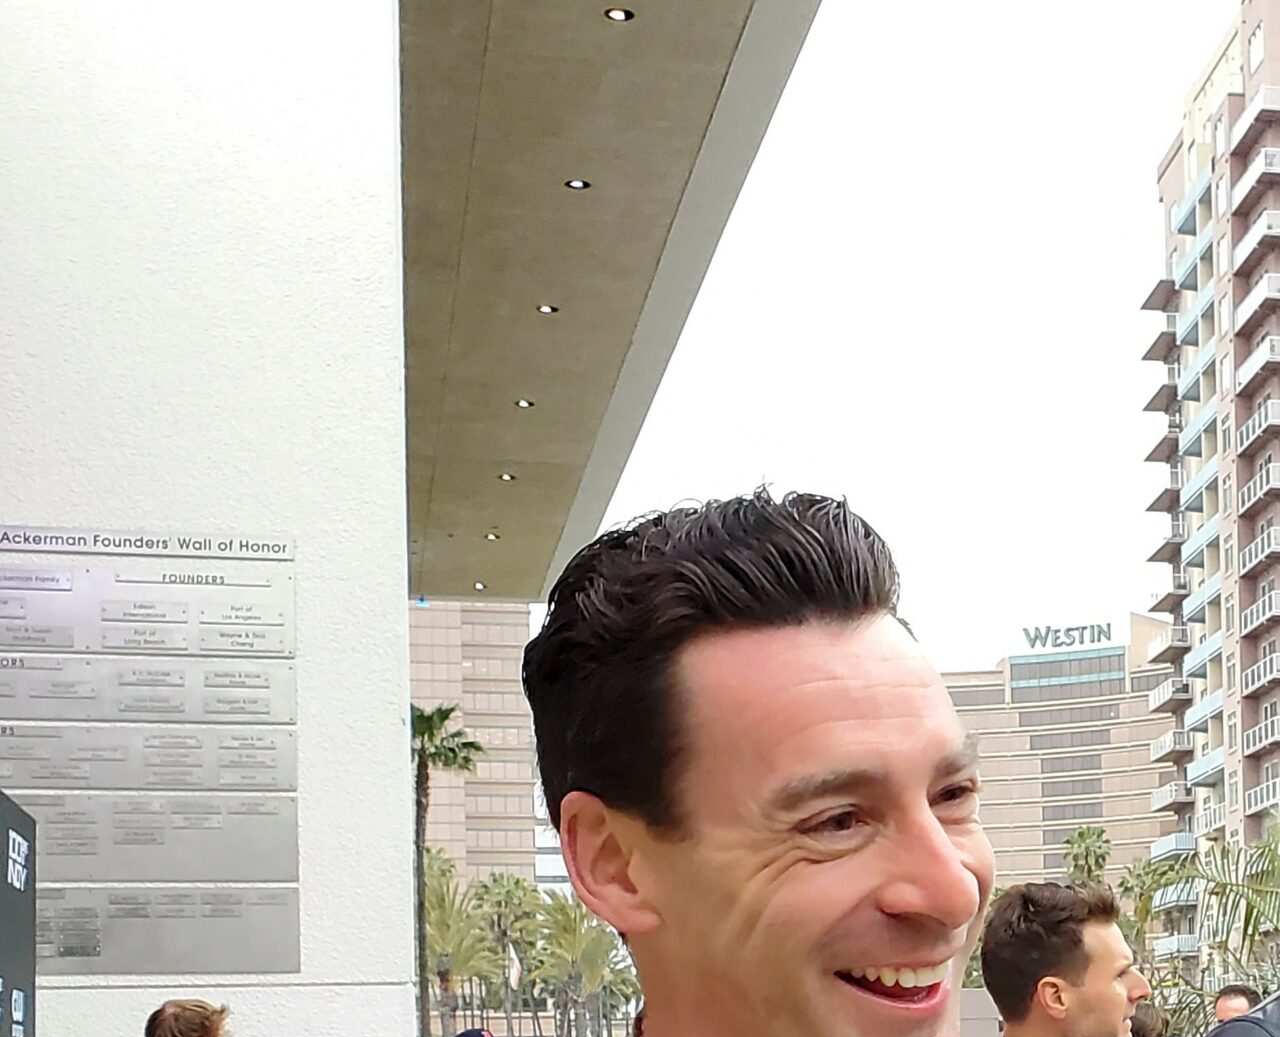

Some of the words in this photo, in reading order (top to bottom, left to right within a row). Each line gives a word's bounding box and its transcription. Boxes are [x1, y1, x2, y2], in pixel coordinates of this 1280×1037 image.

[0, 531, 87, 547] Ackerman
[93, 534, 172, 550] Founders'
[177, 537, 212, 551] Wall
[217, 539, 233, 552] of
[239, 540, 287, 553] Honor
[162, 573, 225, 585] FOUNDERS
[1022, 623, 1112, 649] WESTIN
